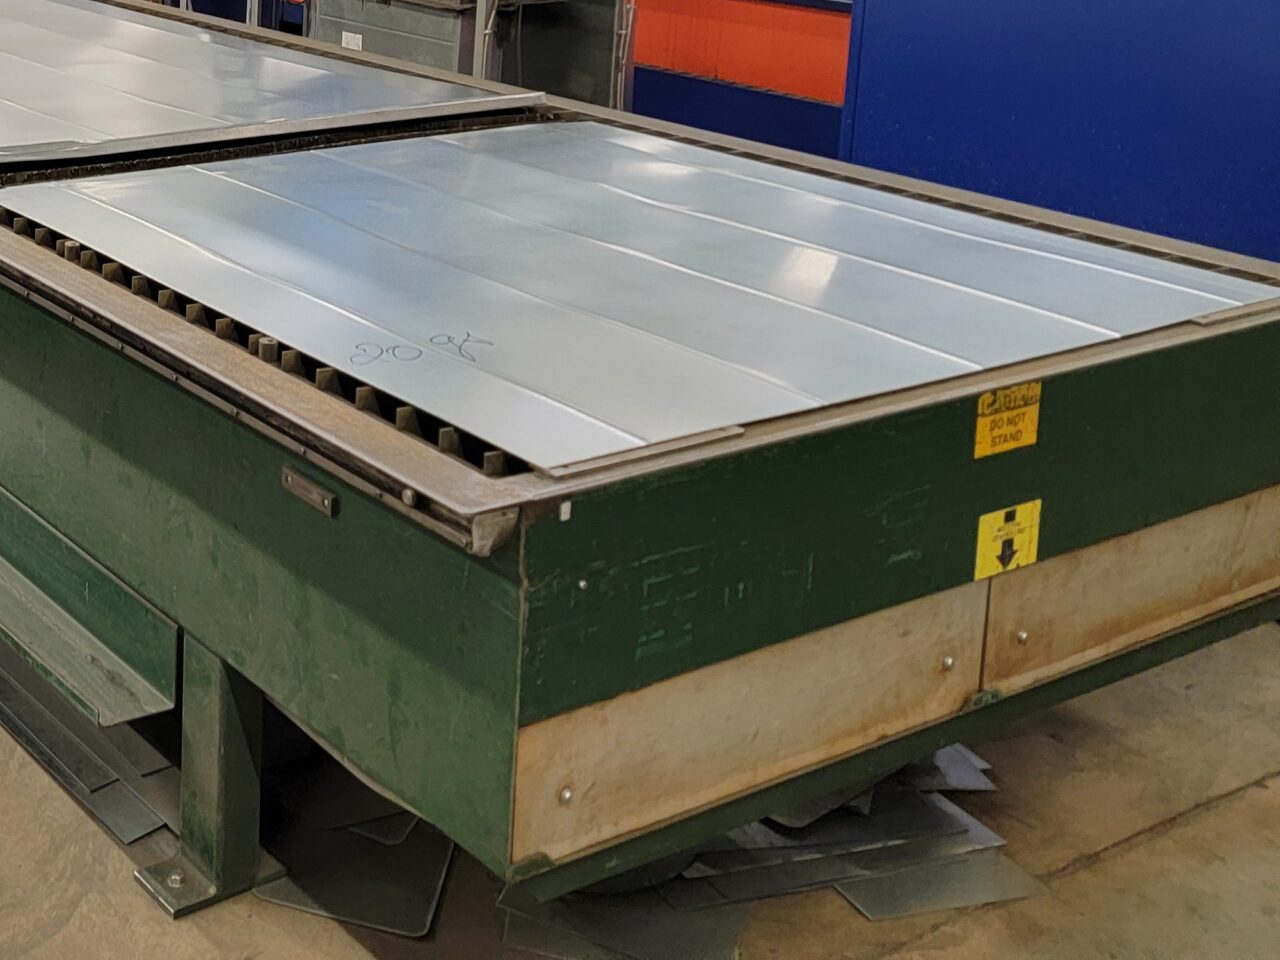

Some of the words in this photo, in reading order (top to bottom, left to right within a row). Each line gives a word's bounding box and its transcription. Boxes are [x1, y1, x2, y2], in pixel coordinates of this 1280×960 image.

[990, 415, 1005, 431] DO
[1006, 411, 1027, 427] NOT
[990, 429, 1023, 448] STAND
